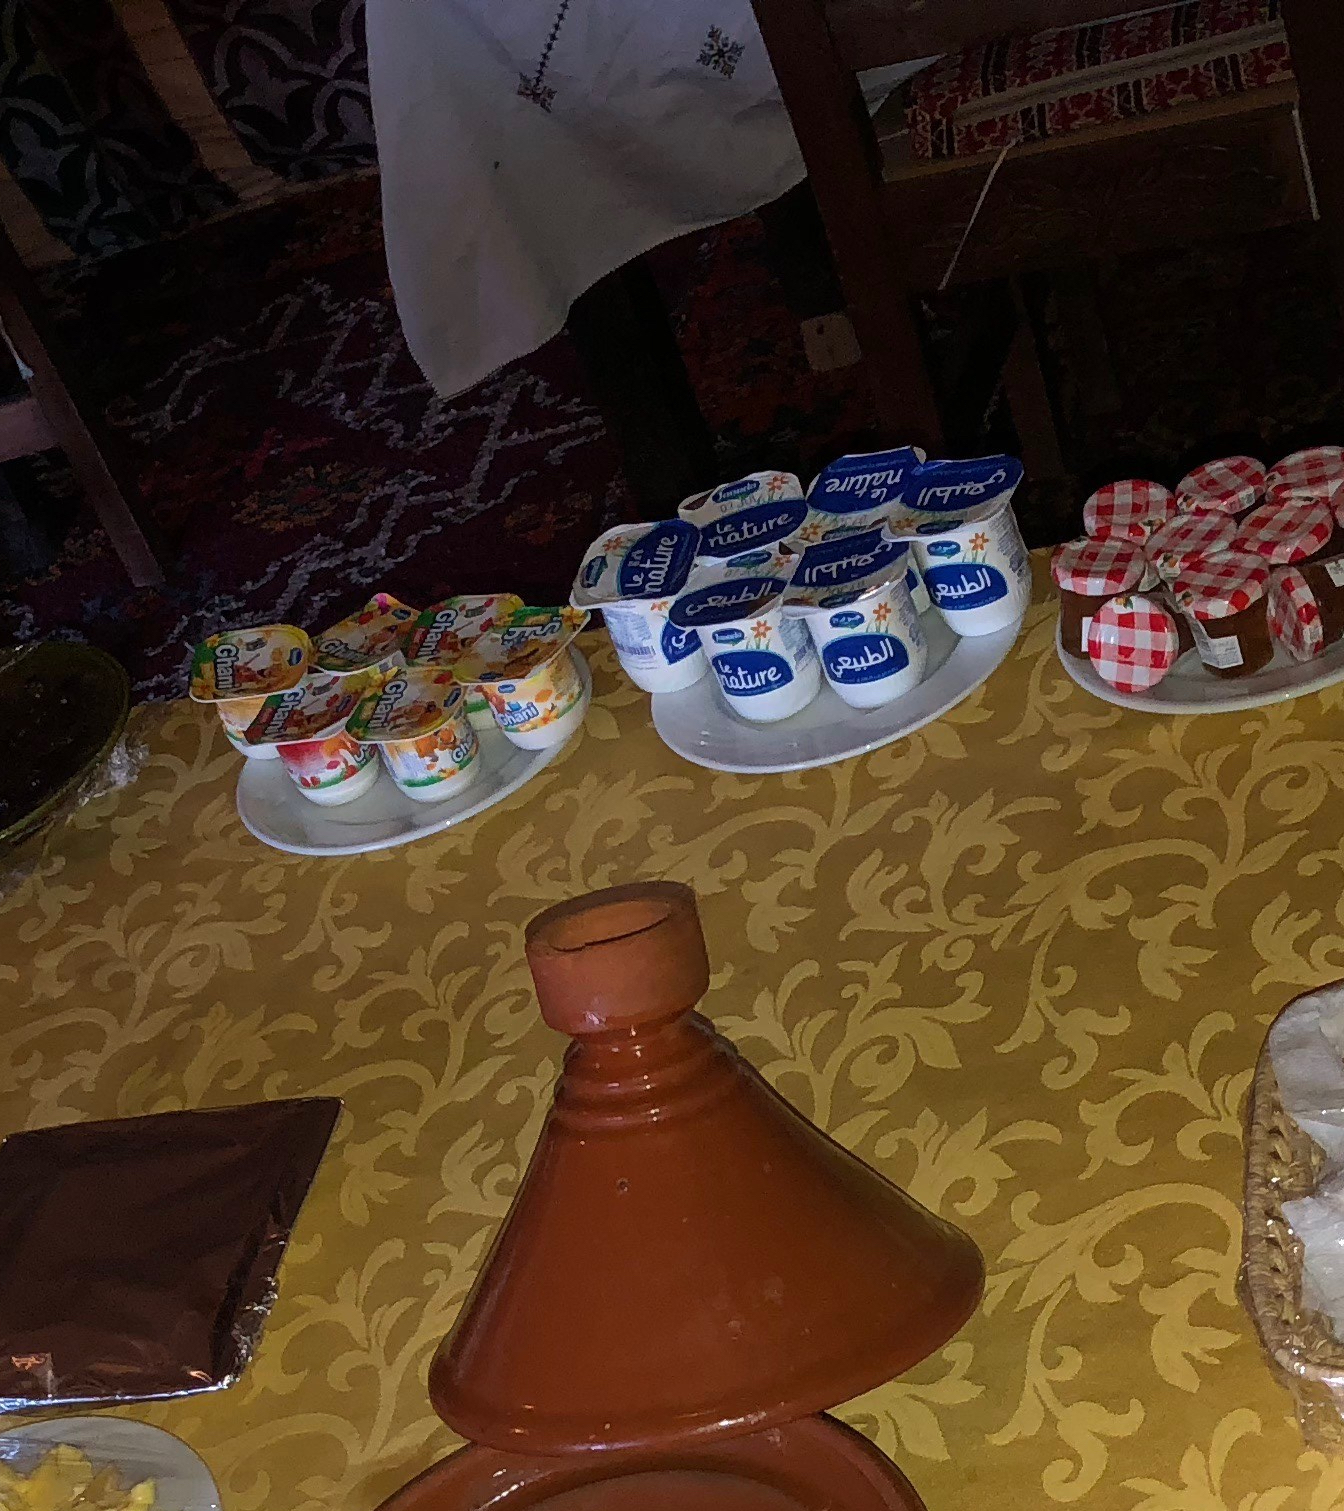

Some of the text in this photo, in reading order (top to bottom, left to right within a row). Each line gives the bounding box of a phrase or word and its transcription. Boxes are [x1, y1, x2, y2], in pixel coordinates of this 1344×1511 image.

[824, 467, 904, 498] nature
[708, 512, 794, 547] nature
[639, 534, 679, 595] nature
[215, 644, 240, 690] Ghani
[719, 665, 783, 690] nature
[369, 679, 407, 729] Ghani
